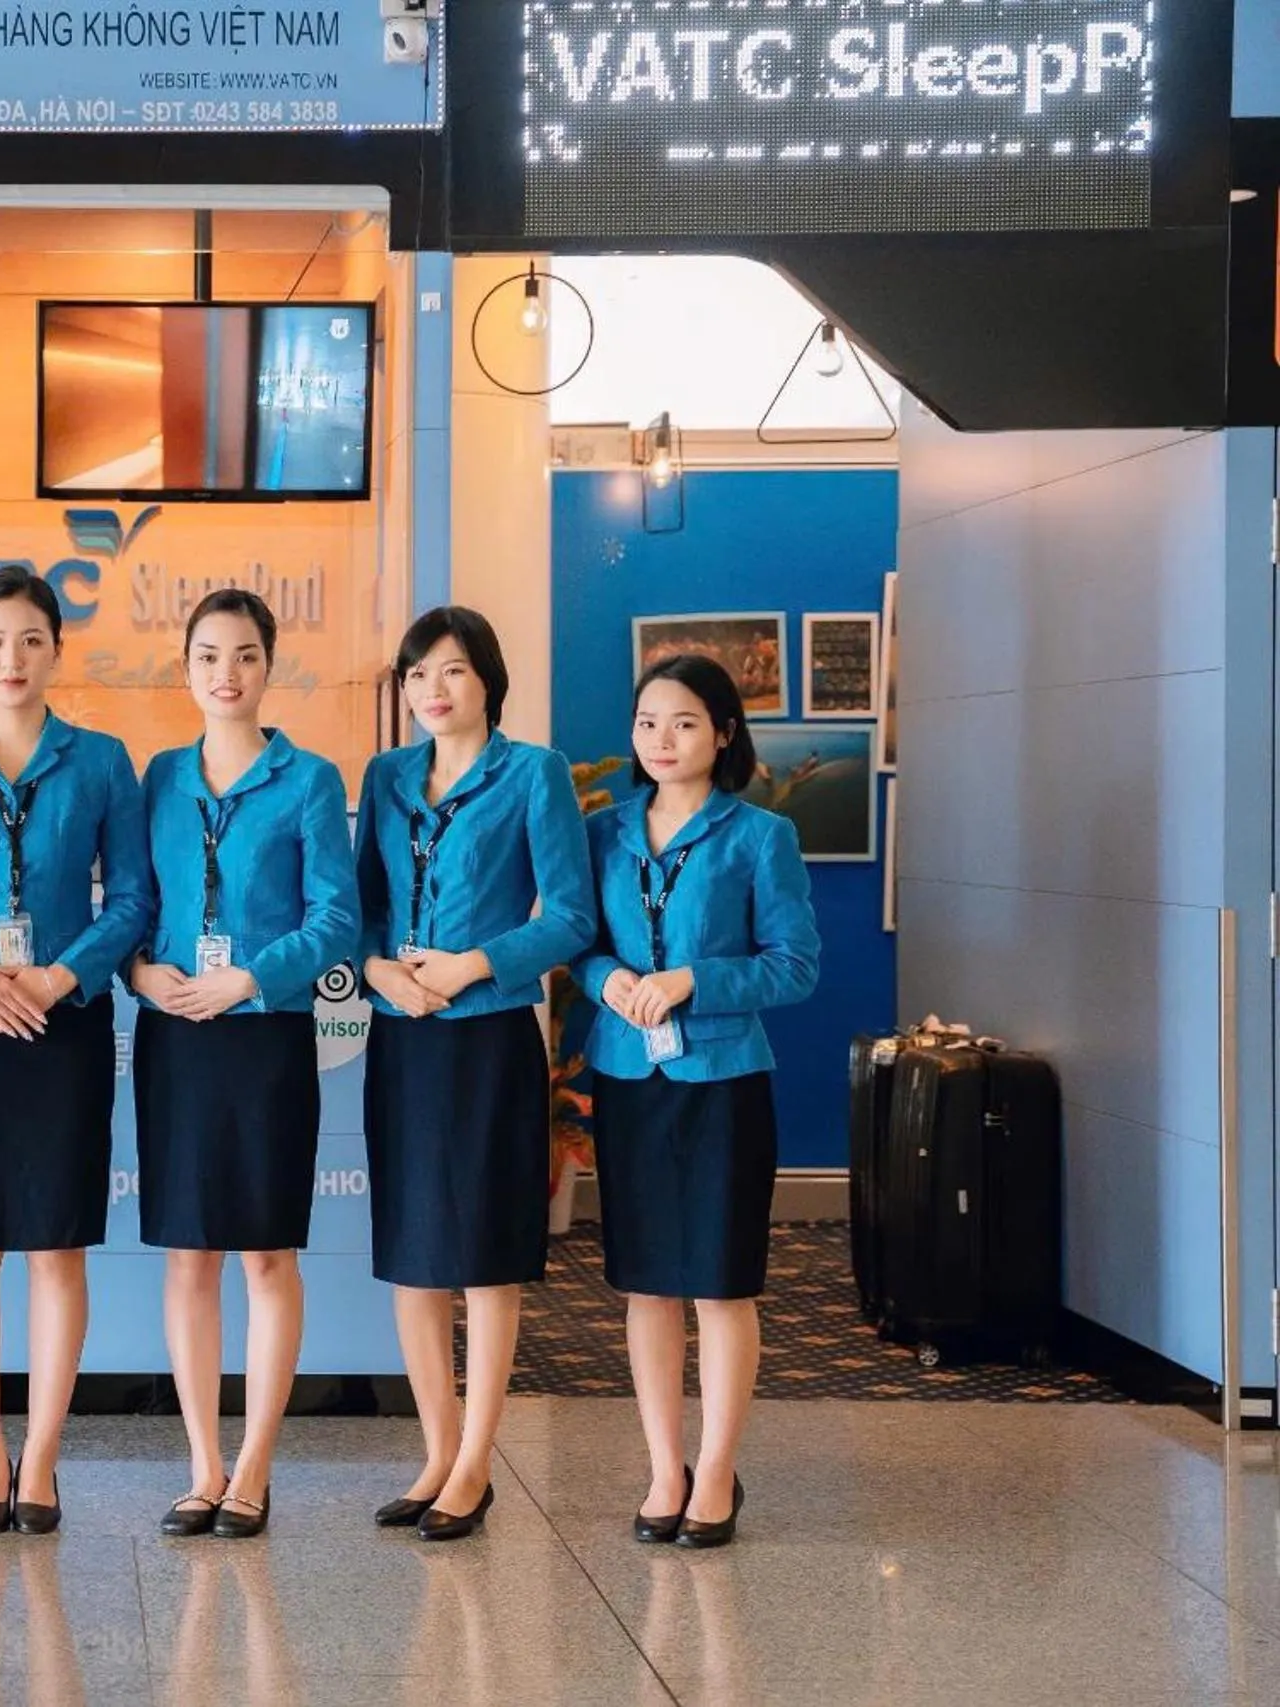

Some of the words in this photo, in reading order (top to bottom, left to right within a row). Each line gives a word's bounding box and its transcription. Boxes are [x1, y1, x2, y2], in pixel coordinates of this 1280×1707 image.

[83, 4, 191, 47] KHÔNG
[201, 5, 266, 54] VIỆT
[275, 11, 339, 47] NAM
[548, 30, 793, 102] VATC
[827, 21, 1144, 114] SleepP
[77, 97, 115, 126] NỘI
[247, 101, 282, 122] 584
[290, 101, 338, 122] 3838
[131, 561, 326, 624] SlePod
[314, 1016, 369, 1037] visor
